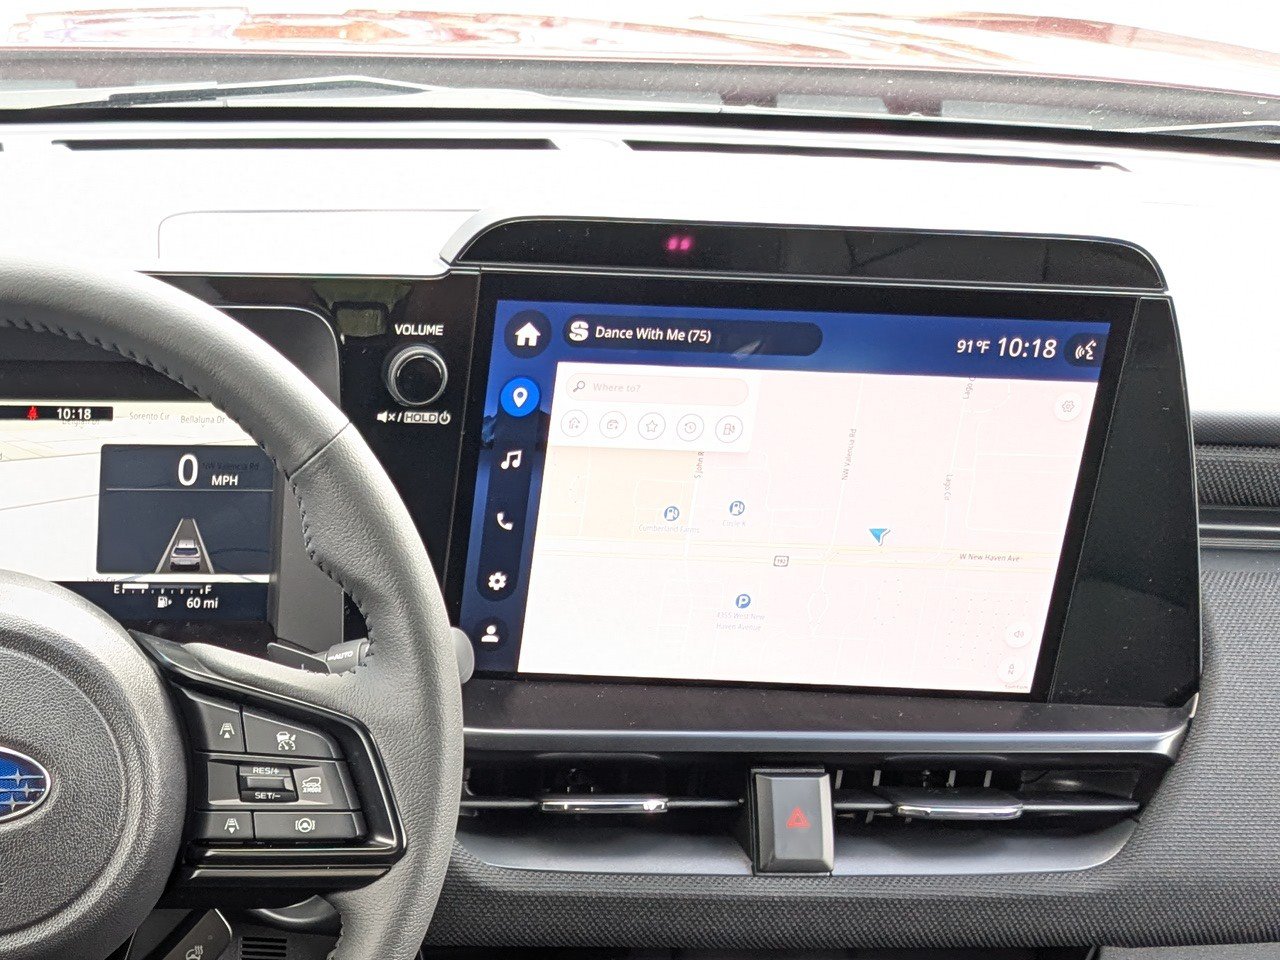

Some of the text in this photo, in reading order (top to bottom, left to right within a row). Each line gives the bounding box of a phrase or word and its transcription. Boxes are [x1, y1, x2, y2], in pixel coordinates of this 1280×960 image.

[394, 323, 444, 336] VOLUME
[595, 326, 712, 344] Dance With Me (75)
[997, 337, 1057, 358] 10:18
[593, 382, 641, 393] Where to?
[56, 407, 91, 420] 10:18
[129, 411, 159, 421] Sorento
[405, 412, 437, 423] HOLD
[180, 415, 225, 424] Bellaluna Dr
[178, 453, 199, 487] 0
[211, 475, 239, 486] MPH
[968, 553, 983, 561] New
[985, 554, 1007, 562] Haven
[1007, 554, 1020, 562] Ave
[113, 585, 120, 594] E
[205, 585, 212, 594] F
[186, 597, 218, 609] 60 mi
